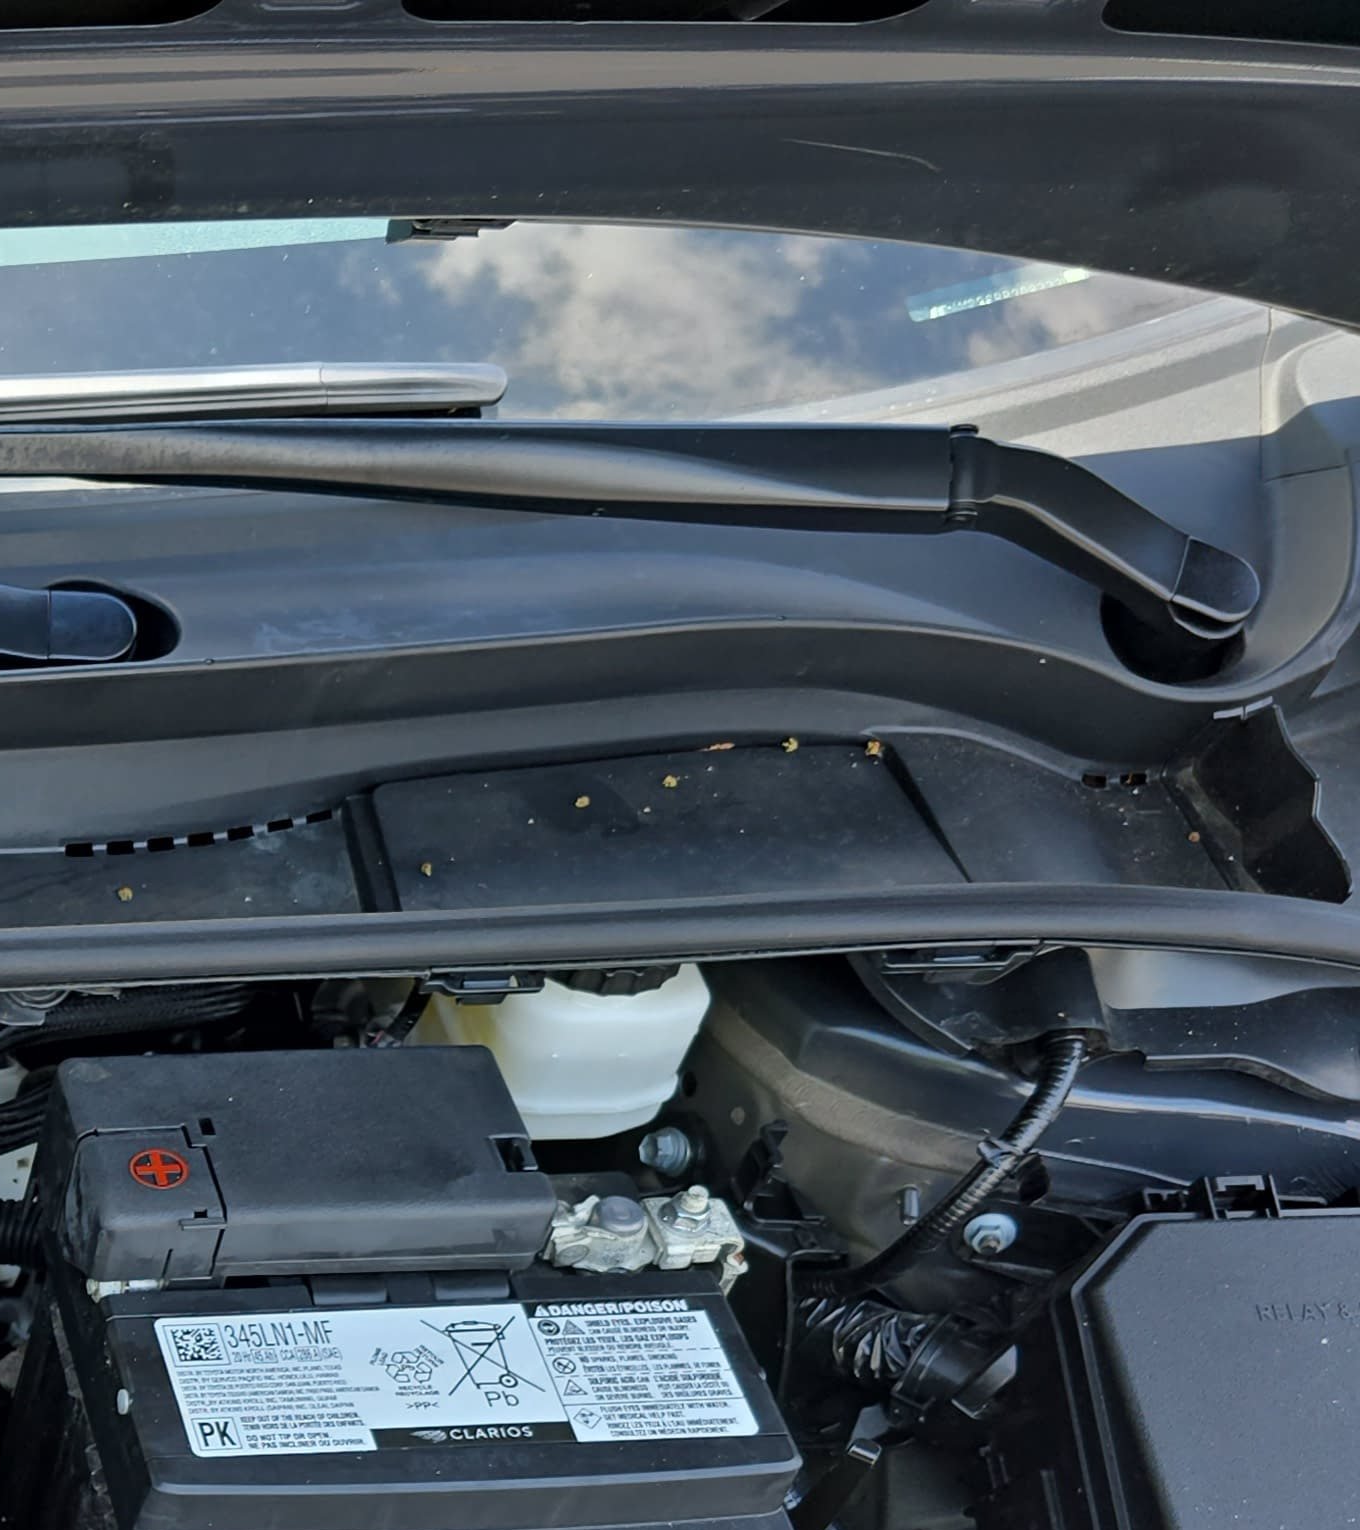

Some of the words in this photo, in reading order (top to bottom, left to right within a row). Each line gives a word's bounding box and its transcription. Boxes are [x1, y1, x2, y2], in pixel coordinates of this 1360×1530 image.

[548, 1299, 688, 1317] DANGER/POISON
[224, 1320, 333, 1348] 345LN1-MF
[484, 1391, 520, 1407] Pb
[197, 1421, 236, 1447] PK
[449, 1426, 533, 1440] CLARIOS
